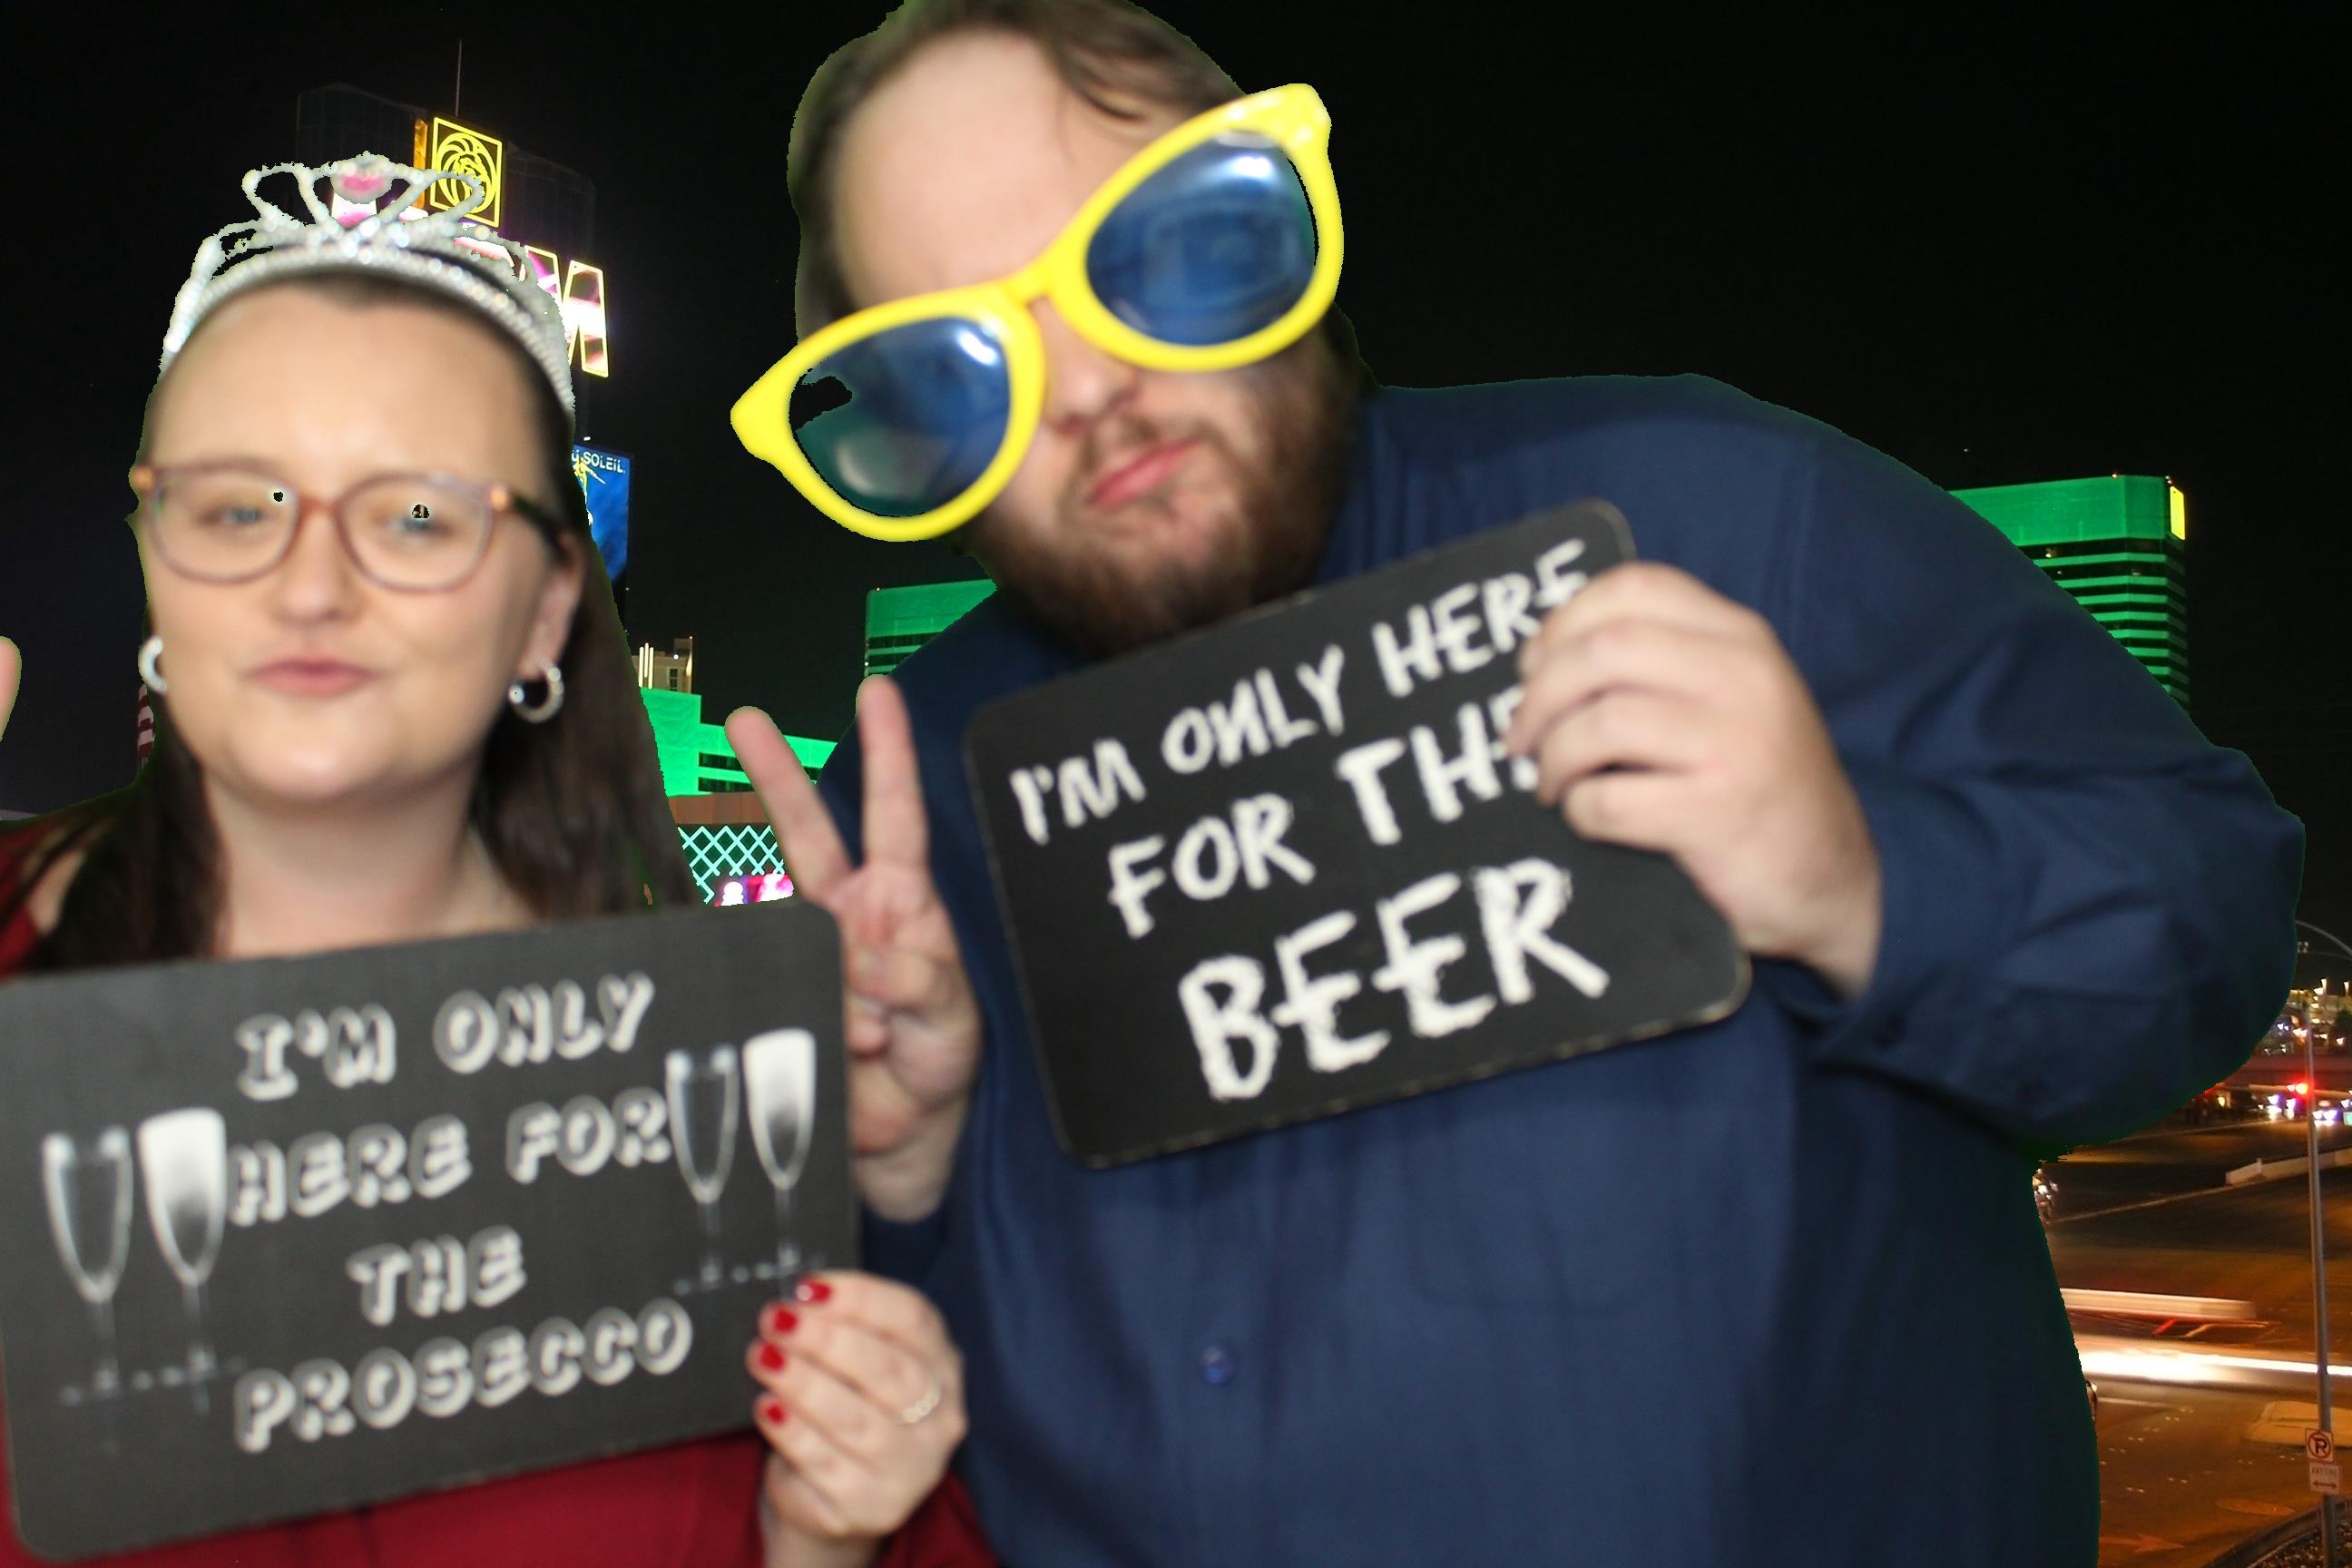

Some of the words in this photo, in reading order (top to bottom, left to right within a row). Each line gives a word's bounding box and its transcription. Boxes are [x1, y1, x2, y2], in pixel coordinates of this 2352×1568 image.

[582, 451, 623, 473] SOLEIL
[1010, 739, 1146, 845] I'M
[1161, 644, 1345, 774] ONLY
[1371, 538, 1588, 698] HERE
[1107, 793, 1316, 938] FOR
[235, 1004, 397, 1102] I'M
[433, 972, 655, 1074] ONLY
[1178, 857, 1610, 1101] BEER
[227, 1113, 473, 1226] HERE
[505, 1088, 672, 1184] FOR
[347, 1225, 528, 1327] THE
[234, 1298, 694, 1454] PROSECCO
